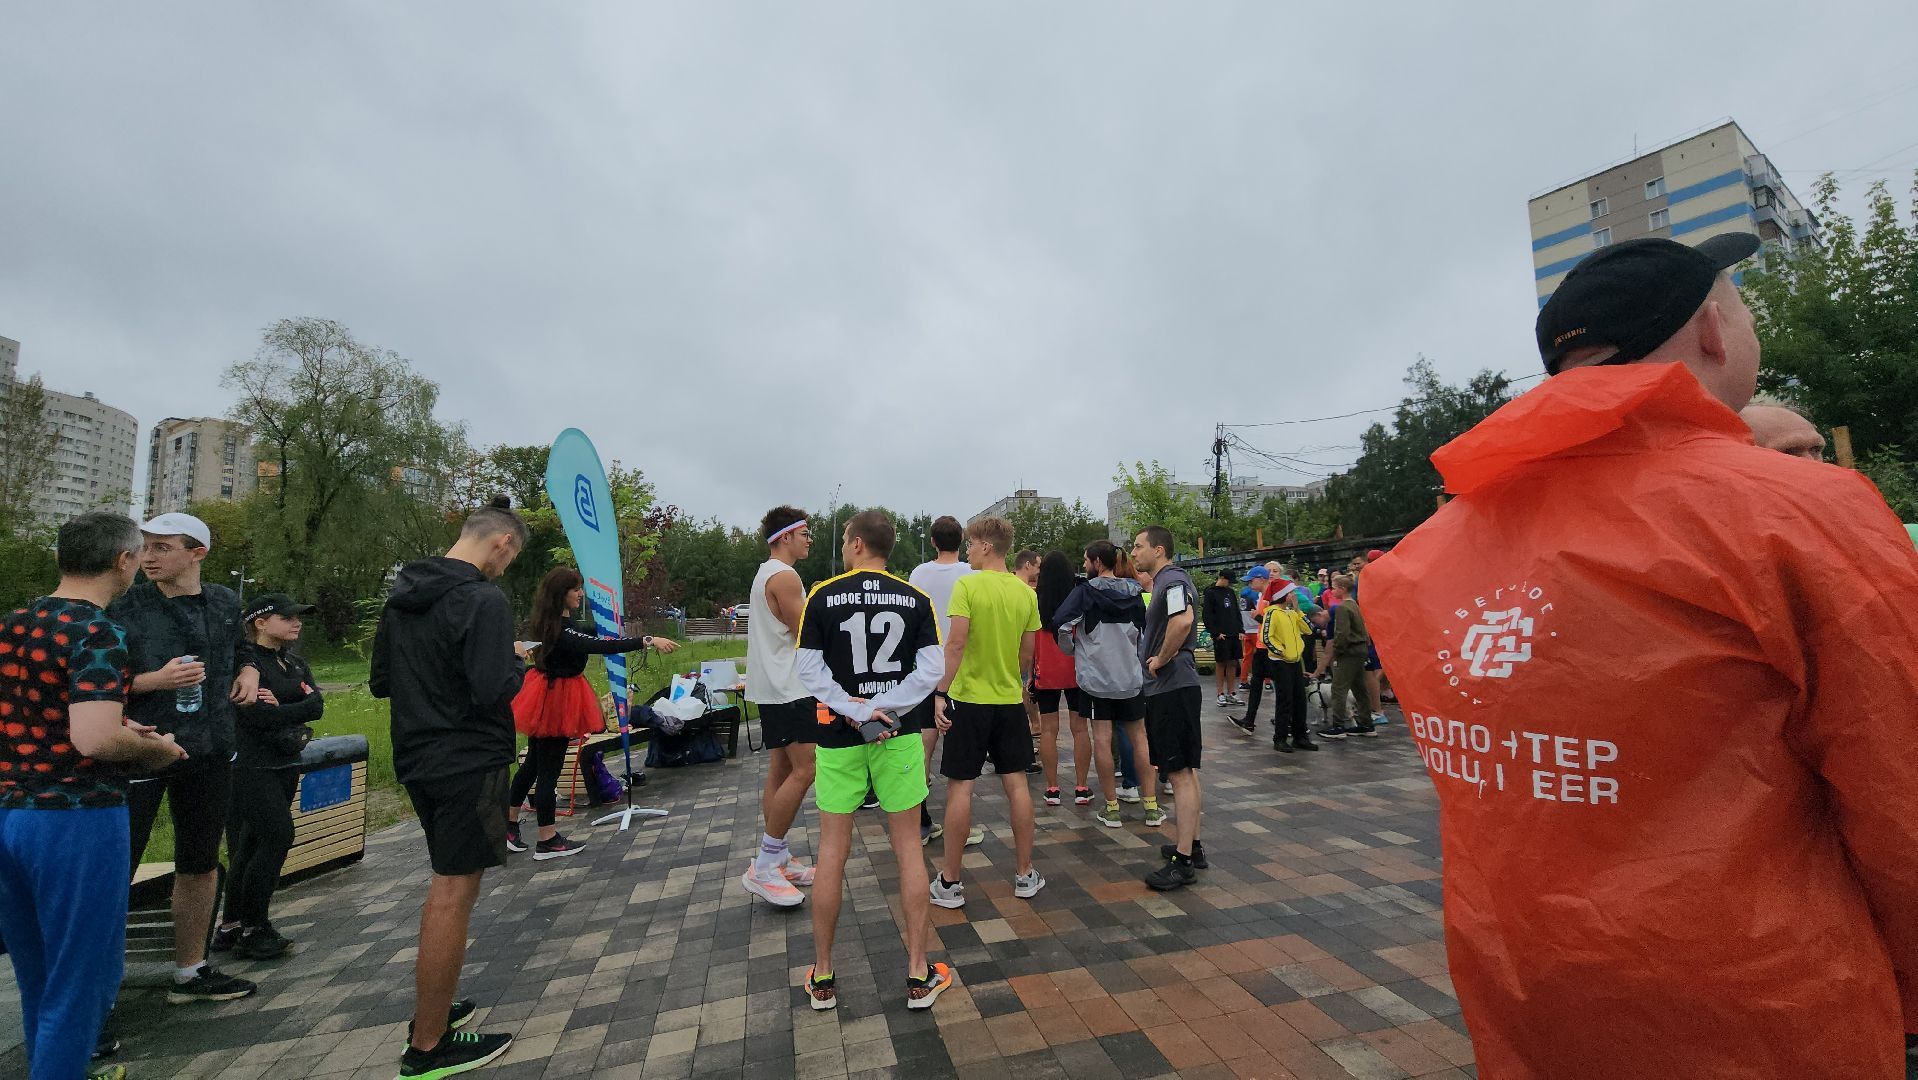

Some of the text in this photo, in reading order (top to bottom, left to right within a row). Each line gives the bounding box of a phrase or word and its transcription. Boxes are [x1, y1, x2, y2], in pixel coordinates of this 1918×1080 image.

[862, 579, 880, 591] ФК
[826, 592, 916, 609] НОВОЕ ПУШКИНО
[839, 611, 906, 675] 12
